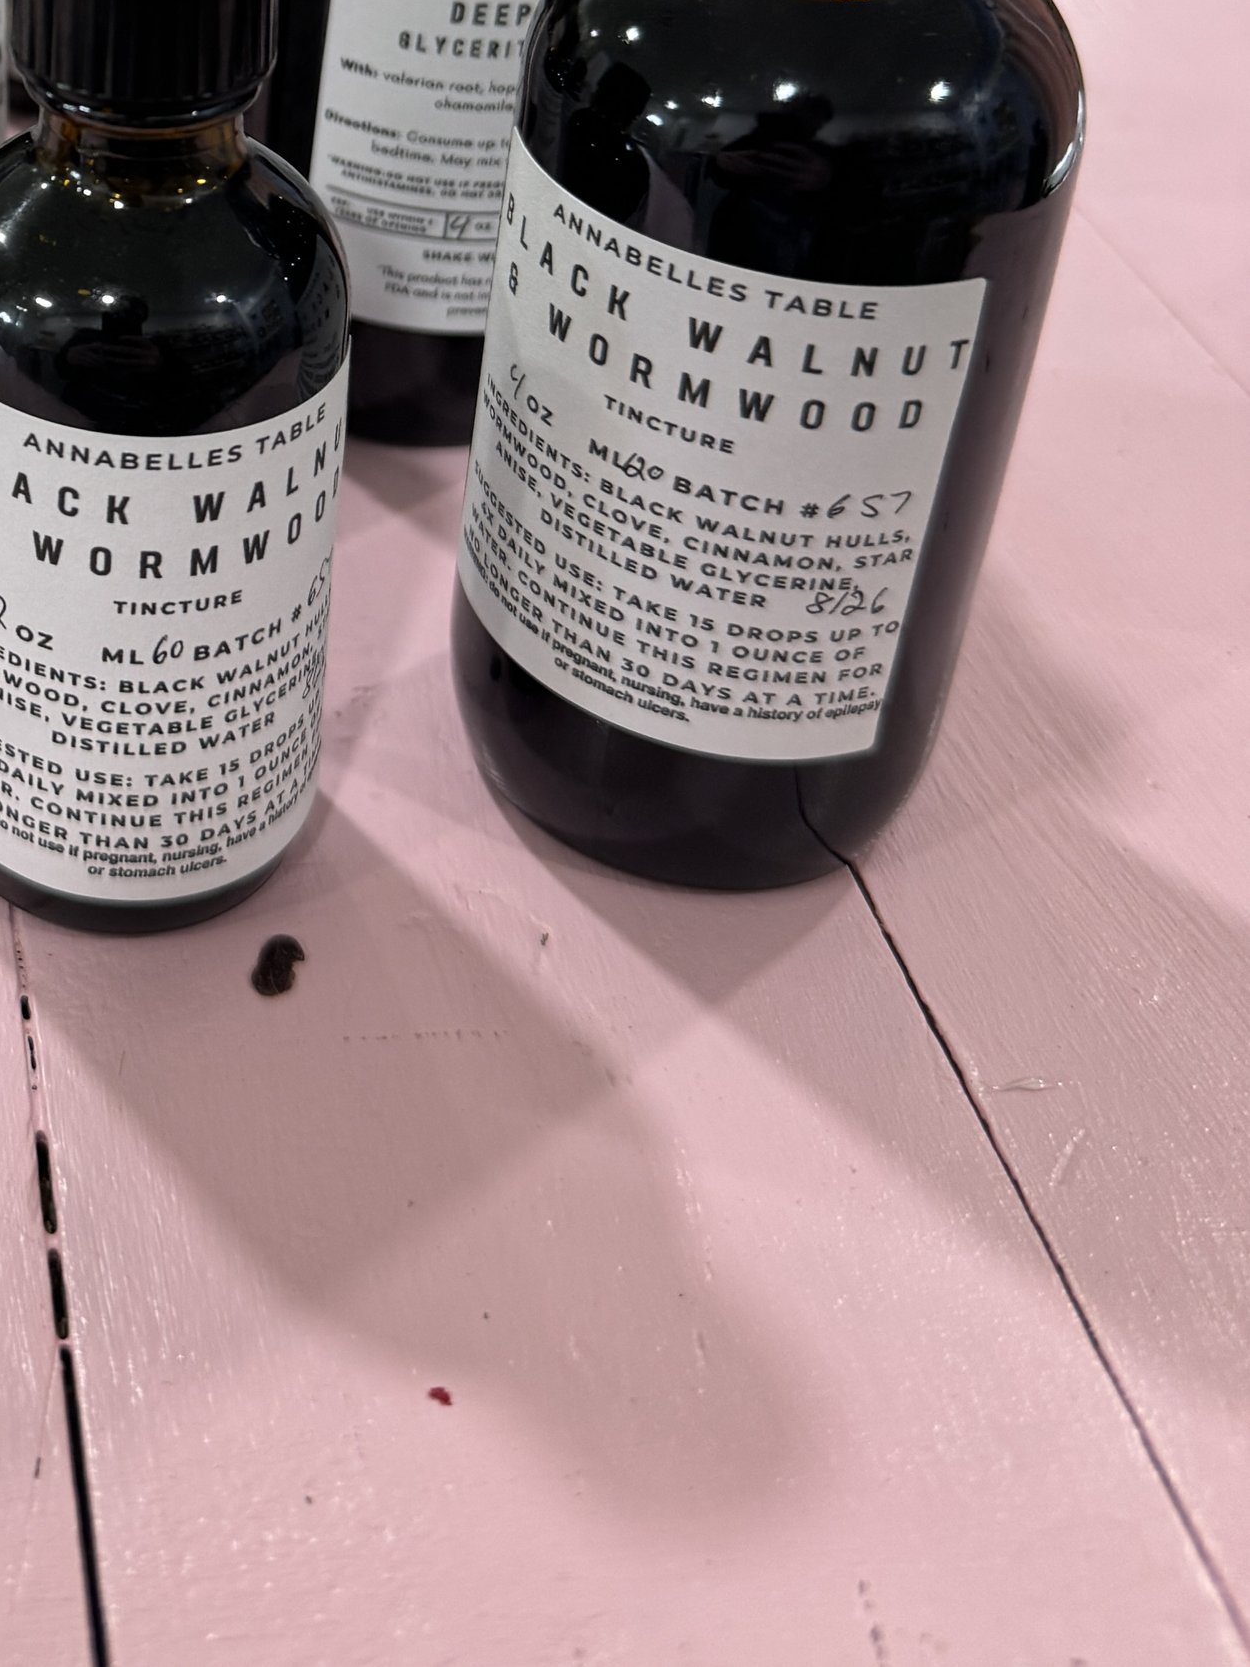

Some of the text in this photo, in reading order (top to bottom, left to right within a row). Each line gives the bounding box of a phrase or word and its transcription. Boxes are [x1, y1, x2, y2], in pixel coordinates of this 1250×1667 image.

[449, 0, 532, 28] DEEP
[506, 191, 631, 323] BLACK
[687, 315, 970, 378] WALNUT
[551, 202, 748, 304] ANNABELLES
[764, 288, 880, 321] TABLE
[508, 260, 519, 297] &
[548, 301, 924, 433] WORMWOOD
[21, 400, 328, 472] ANNABELLES TABLE
[486, 372, 911, 549] INGREDIENTS: BLACK WALNUT HULLS,
[525, 393, 554, 428] OZ
[672, 474, 785, 516] BATCH
[826, 489, 912, 519] 657
[603, 393, 736, 455] TINCTURE
[193, 415, 343, 524] WALNU
[483, 387, 914, 572] WORMWOOD, CLOVE, CINNAMON, STAR
[540, 506, 659, 581] DISTILLED
[669, 573, 768, 608] WATER
[550, 491, 690, 570] VEGETABLE
[699, 562, 859, 592] GLYCERINE,
[112, 588, 244, 617] TINCTURE
[497, 523, 546, 575] DAILY
[552, 573, 626, 622] MIXED
[635, 617, 700, 648] INTO
[731, 644, 824, 665] OUNCE
[833, 645, 867, 663] OF
[517, 569, 884, 685] CONTINUE THIS REGIMEN FOR
[554, 552, 901, 645] USE: TAKE 15 DROPS UP TO
[14, 623, 55, 651] OZ
[101, 645, 145, 666] ML
[151, 633, 185, 665] 60
[192, 617, 282, 662] BATCH
[118, 674, 205, 695] BLACK
[215, 632, 301, 685] WALNUT
[550, 617, 876, 705] THAN 30 DAYS AT TIME.
[60, 711, 214, 736] VEGETABLE
[99, 699, 196, 716] CLOVE,
[570, 665, 634, 705] stomach
[690, 695, 803, 722] have history
[51, 710, 276, 756] DISTILLED WATER
[74, 767, 133, 788] USE:
[143, 767, 210, 788] TAKE
[218, 757, 240, 776] 15
[249, 713, 305, 765] DROPS
[75, 787, 160, 808] MIXED
[170, 781, 230, 807] INTO
[252, 726, 308, 781] OUNCE
[29, 795, 163, 828] CONTINUE
[172, 801, 229, 826] THIS
[236, 743, 309, 810] REGIMEN
[78, 830, 150, 850] THAN
[160, 833, 190, 849] 30
[199, 809, 258, 842] DAYS
[81, 848, 158, 865] pregnant,
[107, 863, 177, 878] stomach
